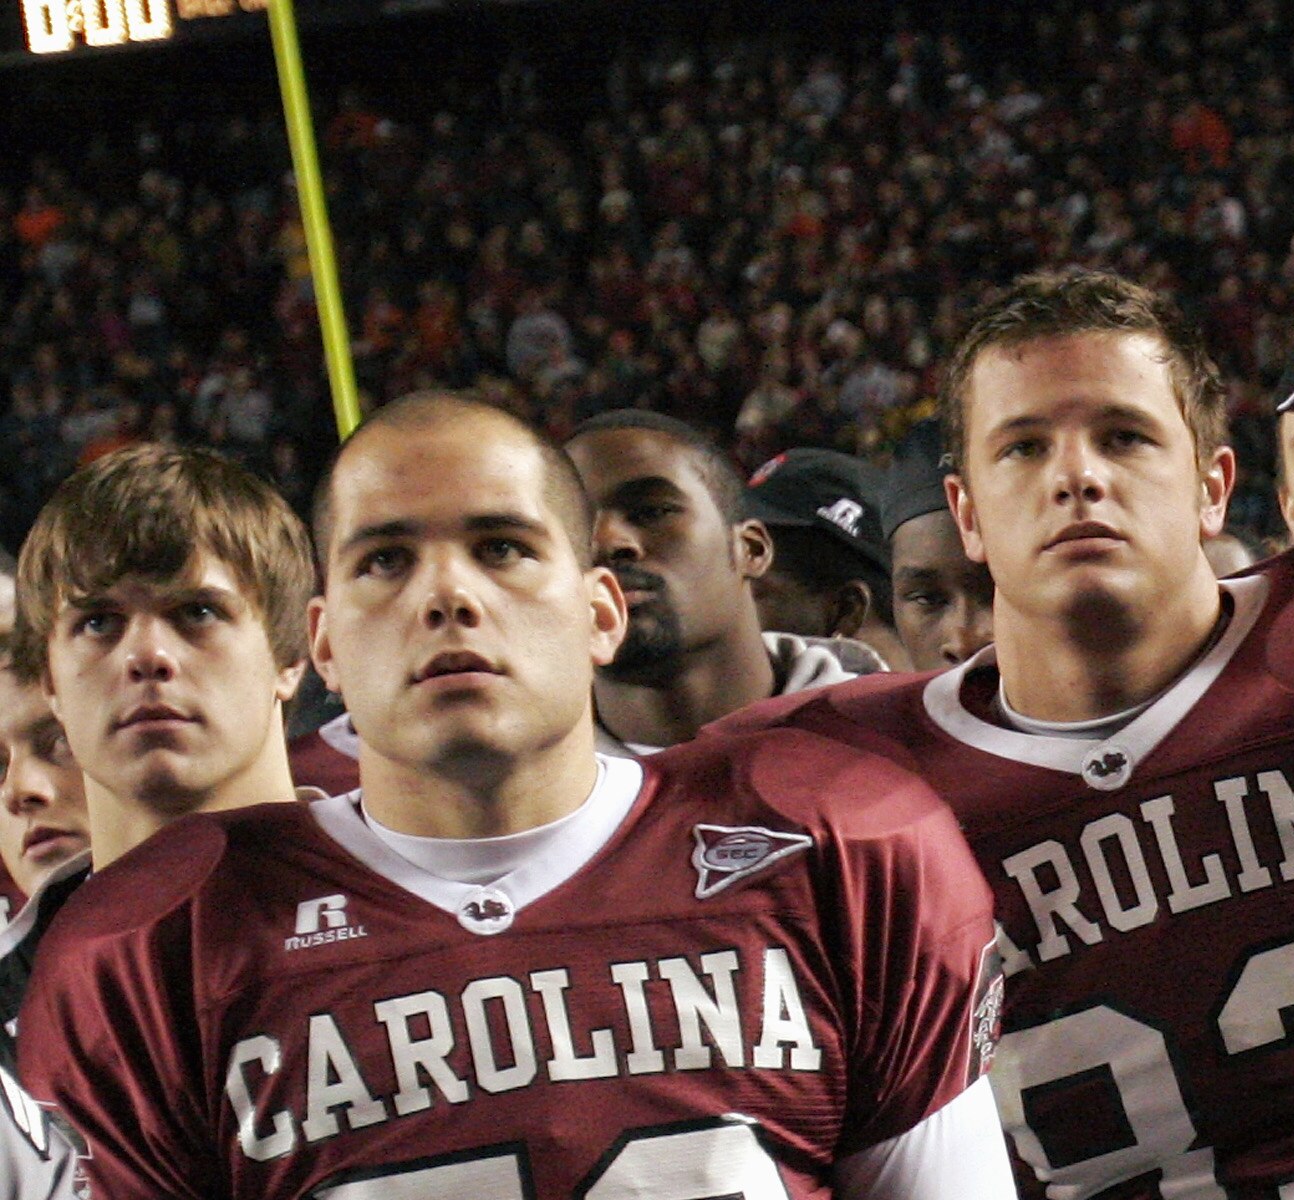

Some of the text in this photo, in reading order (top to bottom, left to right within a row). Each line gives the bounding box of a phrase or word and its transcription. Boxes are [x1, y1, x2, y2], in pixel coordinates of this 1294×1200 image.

[296, 893, 348, 934] R
[284, 925, 368, 951] RUSSELL
[224, 946, 821, 1163] CAROLINA
